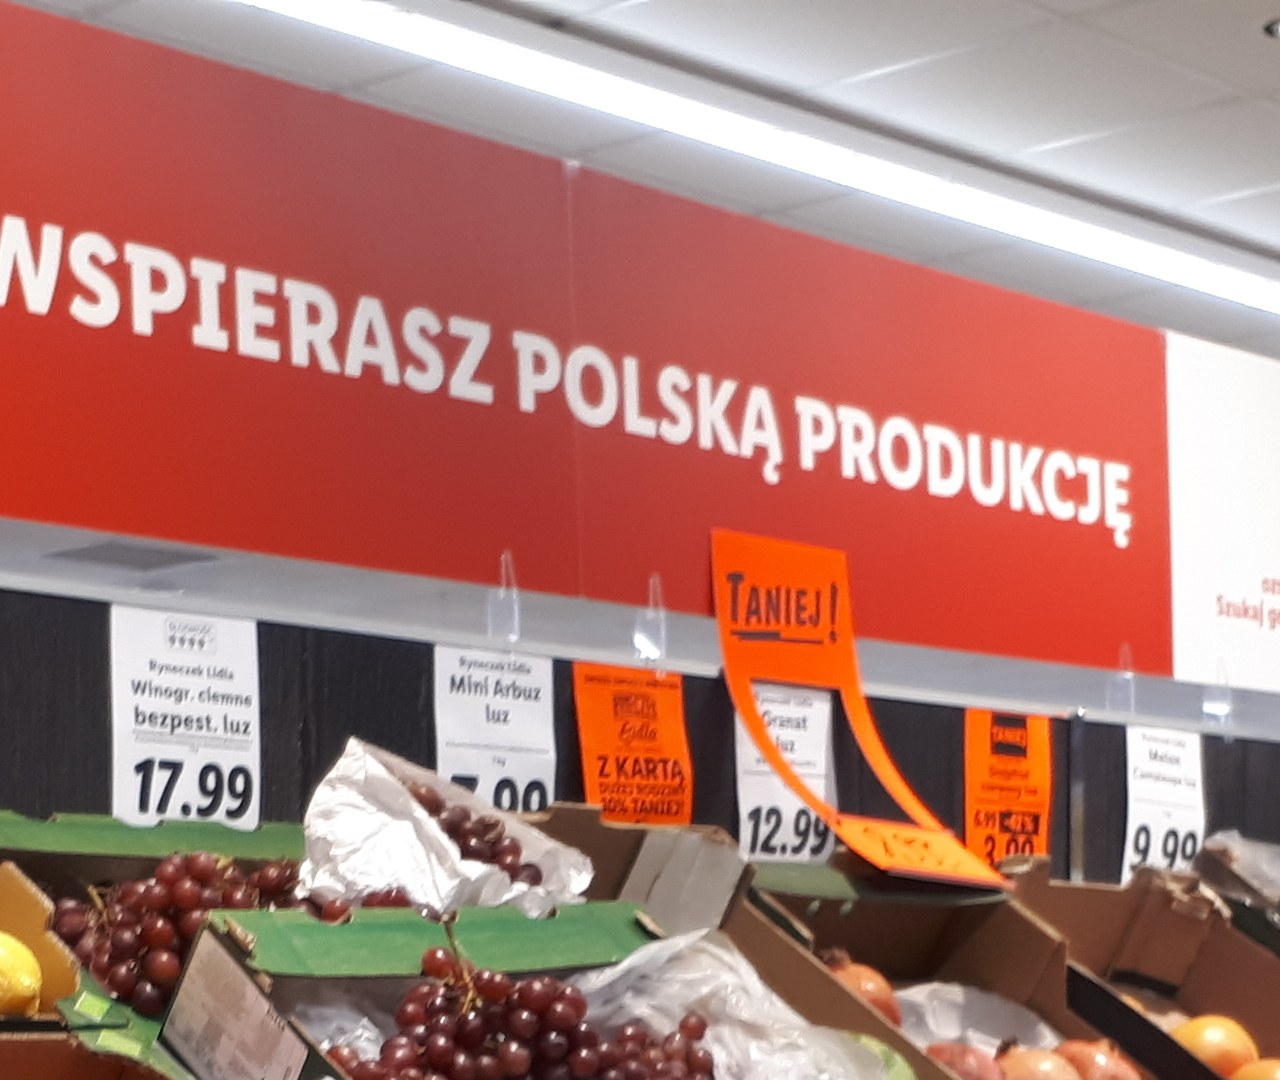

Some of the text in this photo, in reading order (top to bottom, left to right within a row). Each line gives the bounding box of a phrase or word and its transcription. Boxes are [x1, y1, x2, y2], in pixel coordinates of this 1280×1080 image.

[512, 329, 782, 485] POLSKĄ
[794, 395, 1132, 549] PRODUKCJĘ
[131, 678, 195, 706] Winogr.
[448, 674, 542, 703] Mini Arbuz
[134, 704, 252, 736] bezpest. luz
[485, 703, 510, 725] luz
[597, 754, 686, 787] Z KARTĄ
[133, 755, 254, 821] 17.99
[747, 806, 829, 857] 12.99
[1133, 823, 1197, 868] 999
